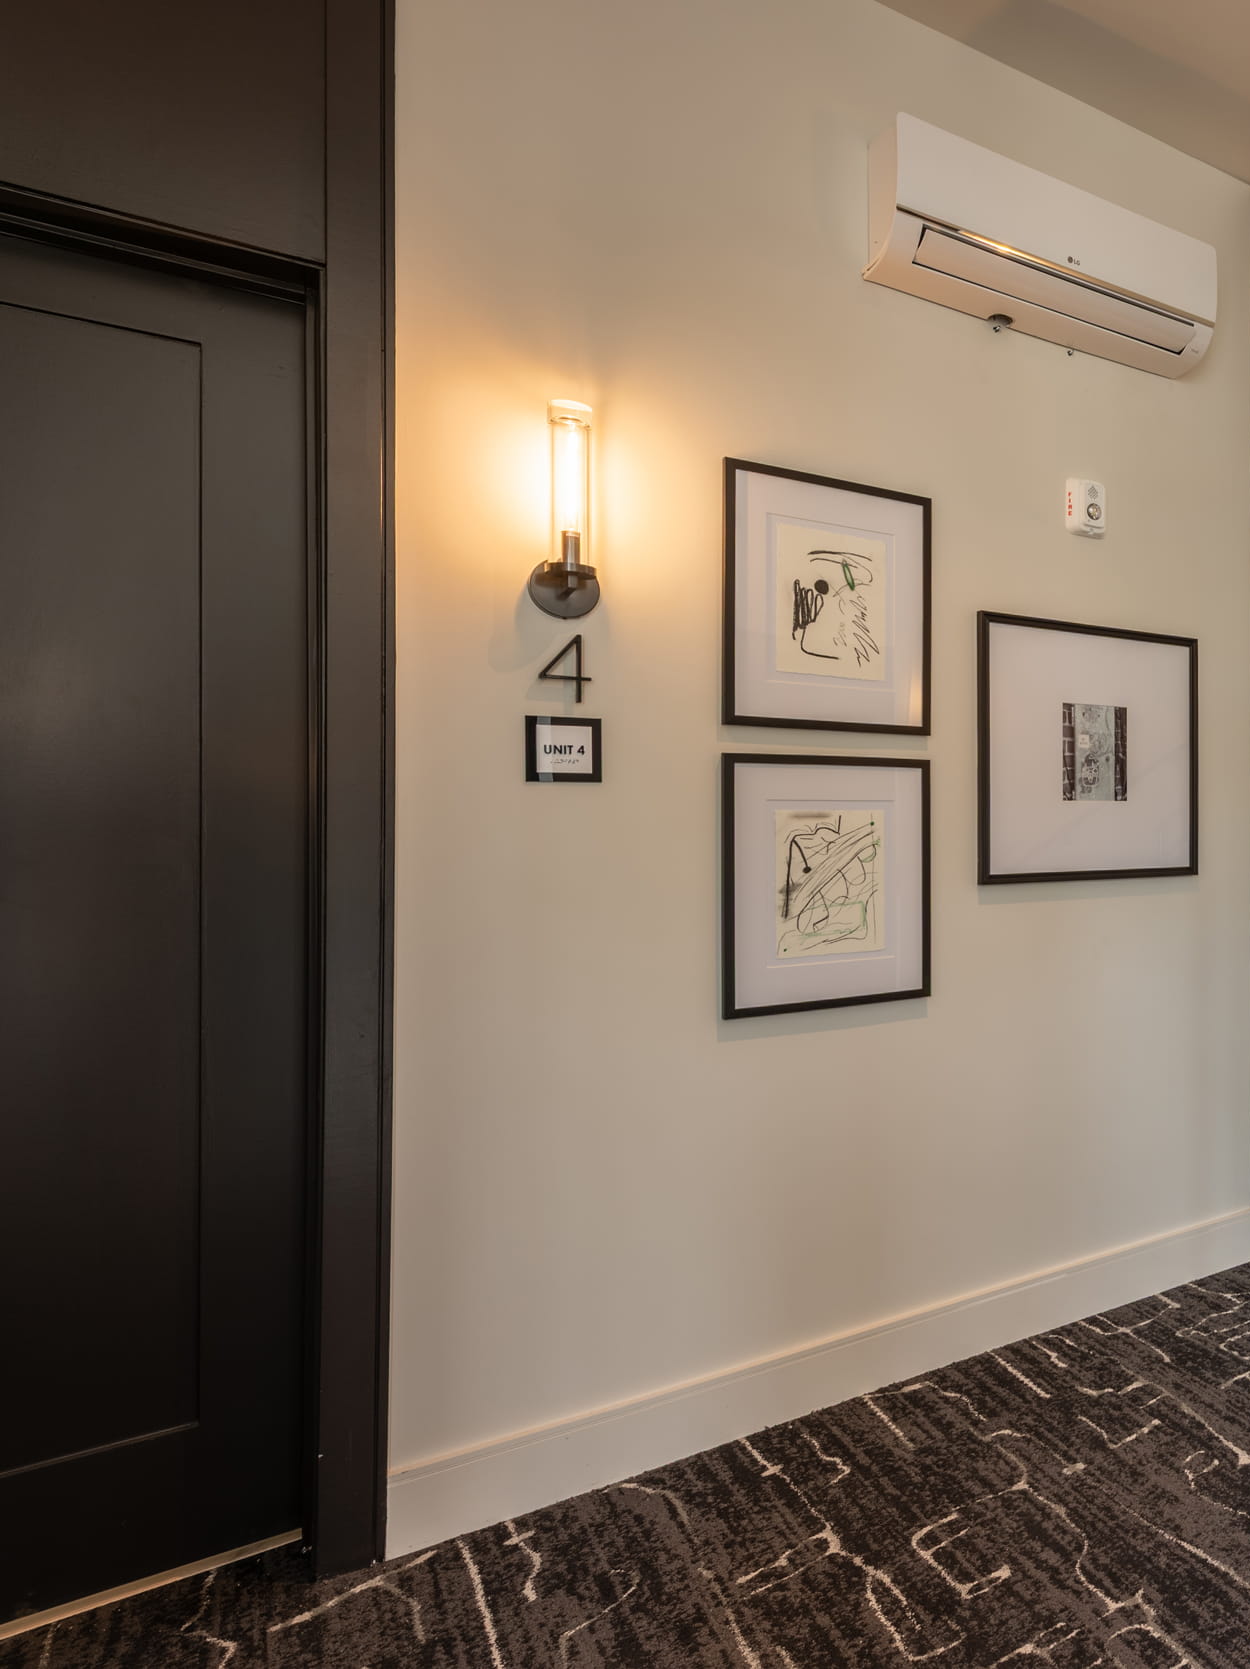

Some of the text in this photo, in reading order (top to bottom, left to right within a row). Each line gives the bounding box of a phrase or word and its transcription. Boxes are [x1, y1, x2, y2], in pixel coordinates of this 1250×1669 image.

[538, 634, 592, 703] 4
[543, 744, 586, 756] UNIT 4
